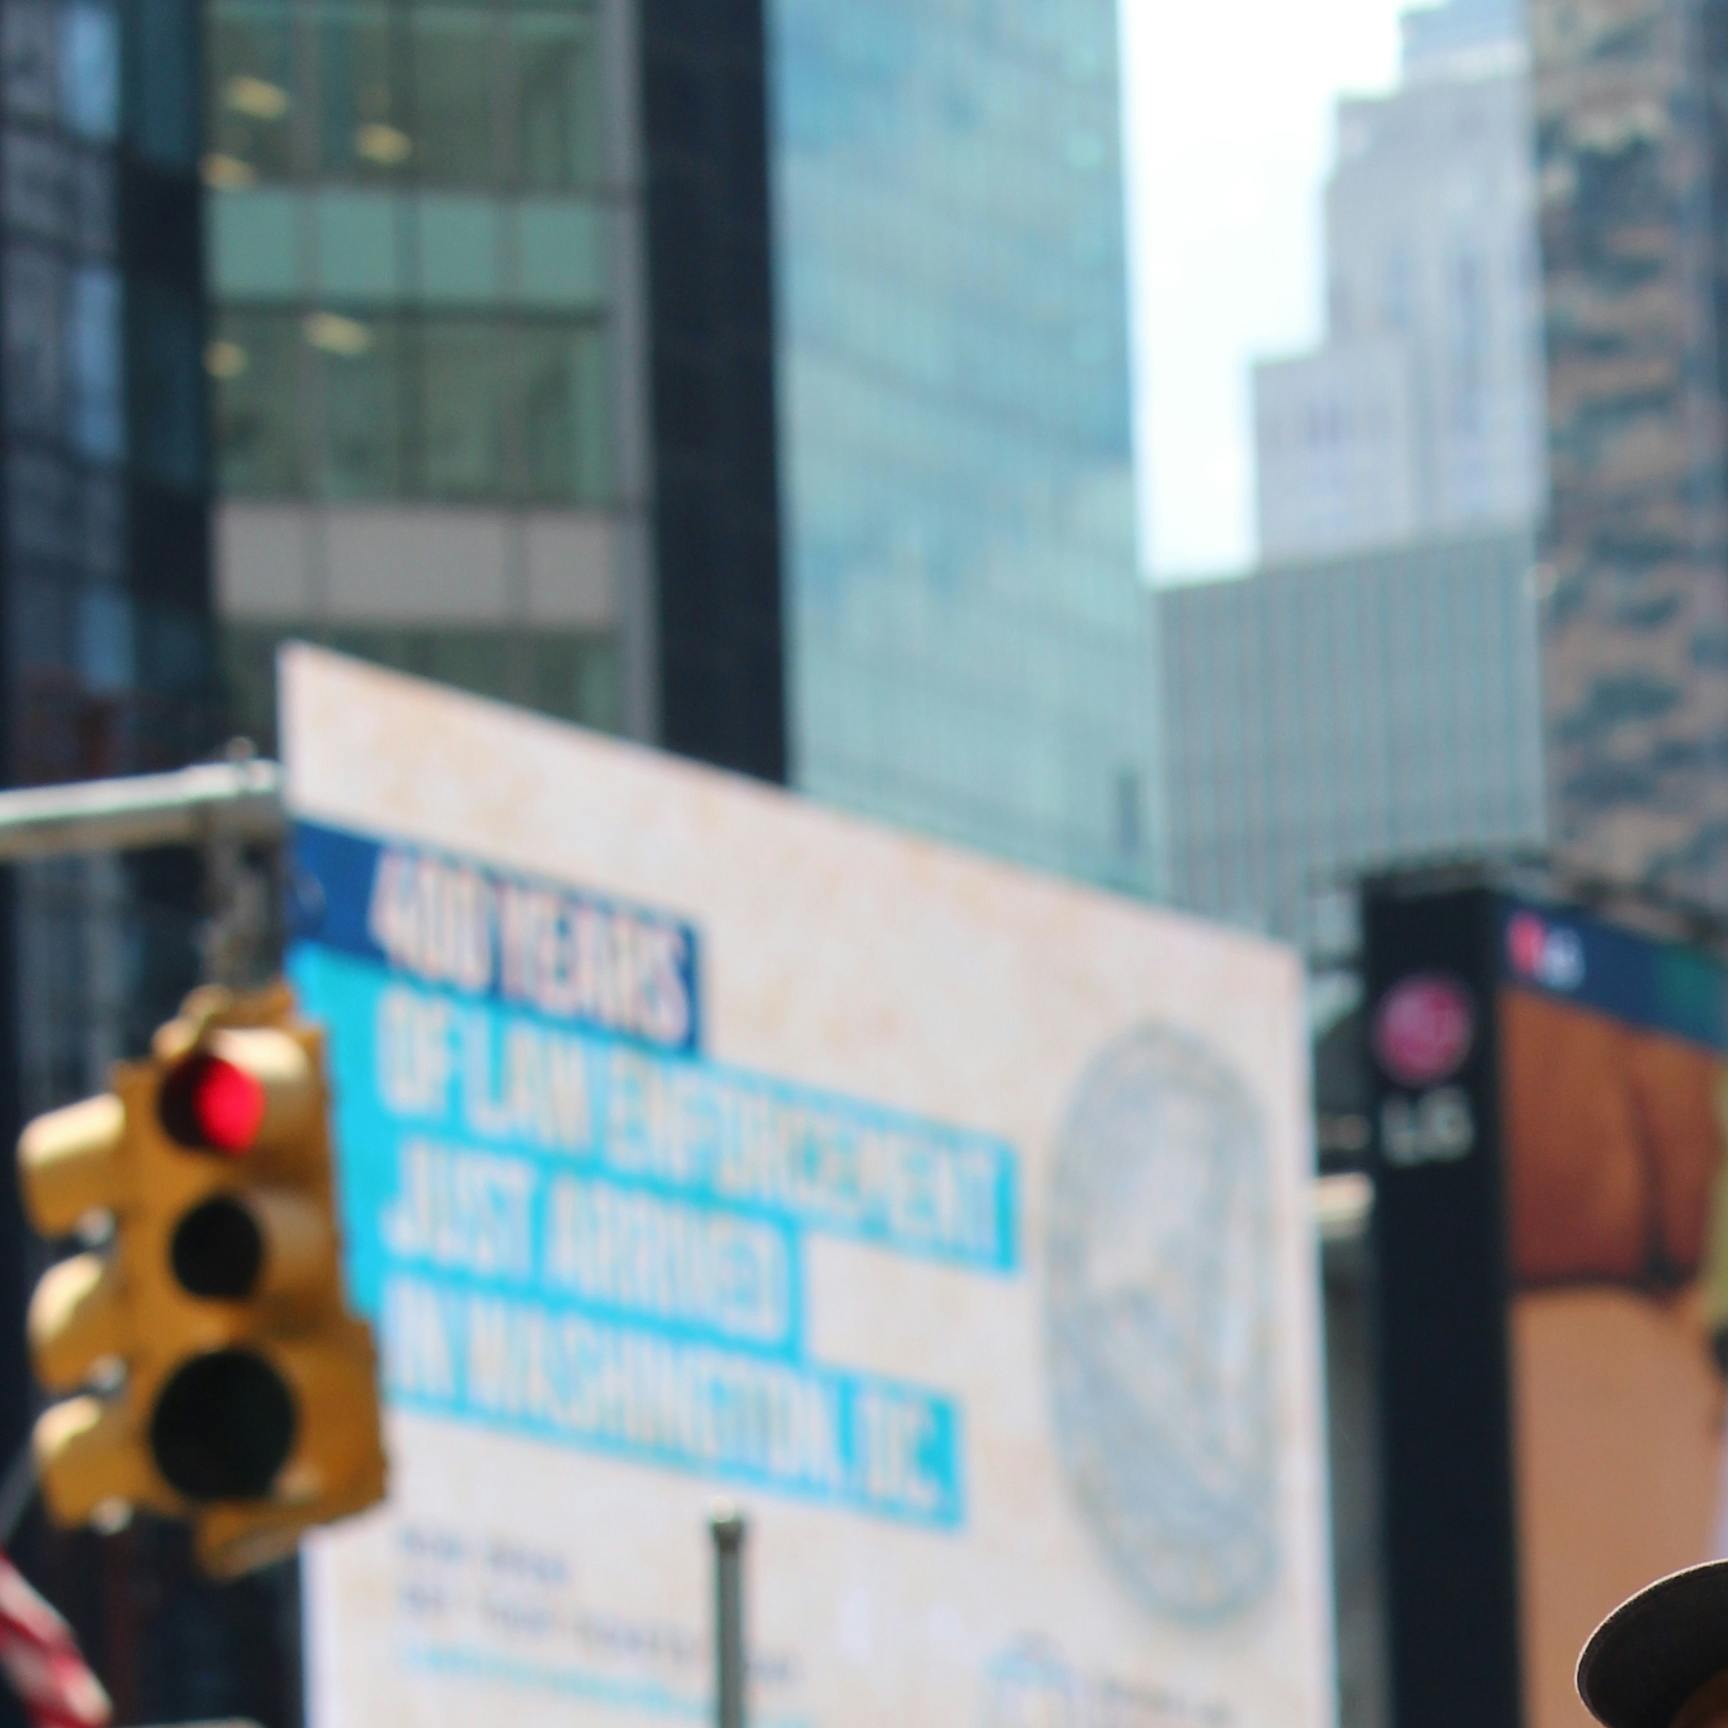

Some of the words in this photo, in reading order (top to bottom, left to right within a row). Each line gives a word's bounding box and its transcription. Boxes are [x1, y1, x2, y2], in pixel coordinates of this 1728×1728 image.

[499, 880, 688, 1046] YEARS
[380, 1135, 533, 1290] JUST
[546, 1172, 787, 1343] ARRIVED
[462, 1005, 592, 1158] LAW
[600, 1040, 1001, 1268] ENFORCEMENT
